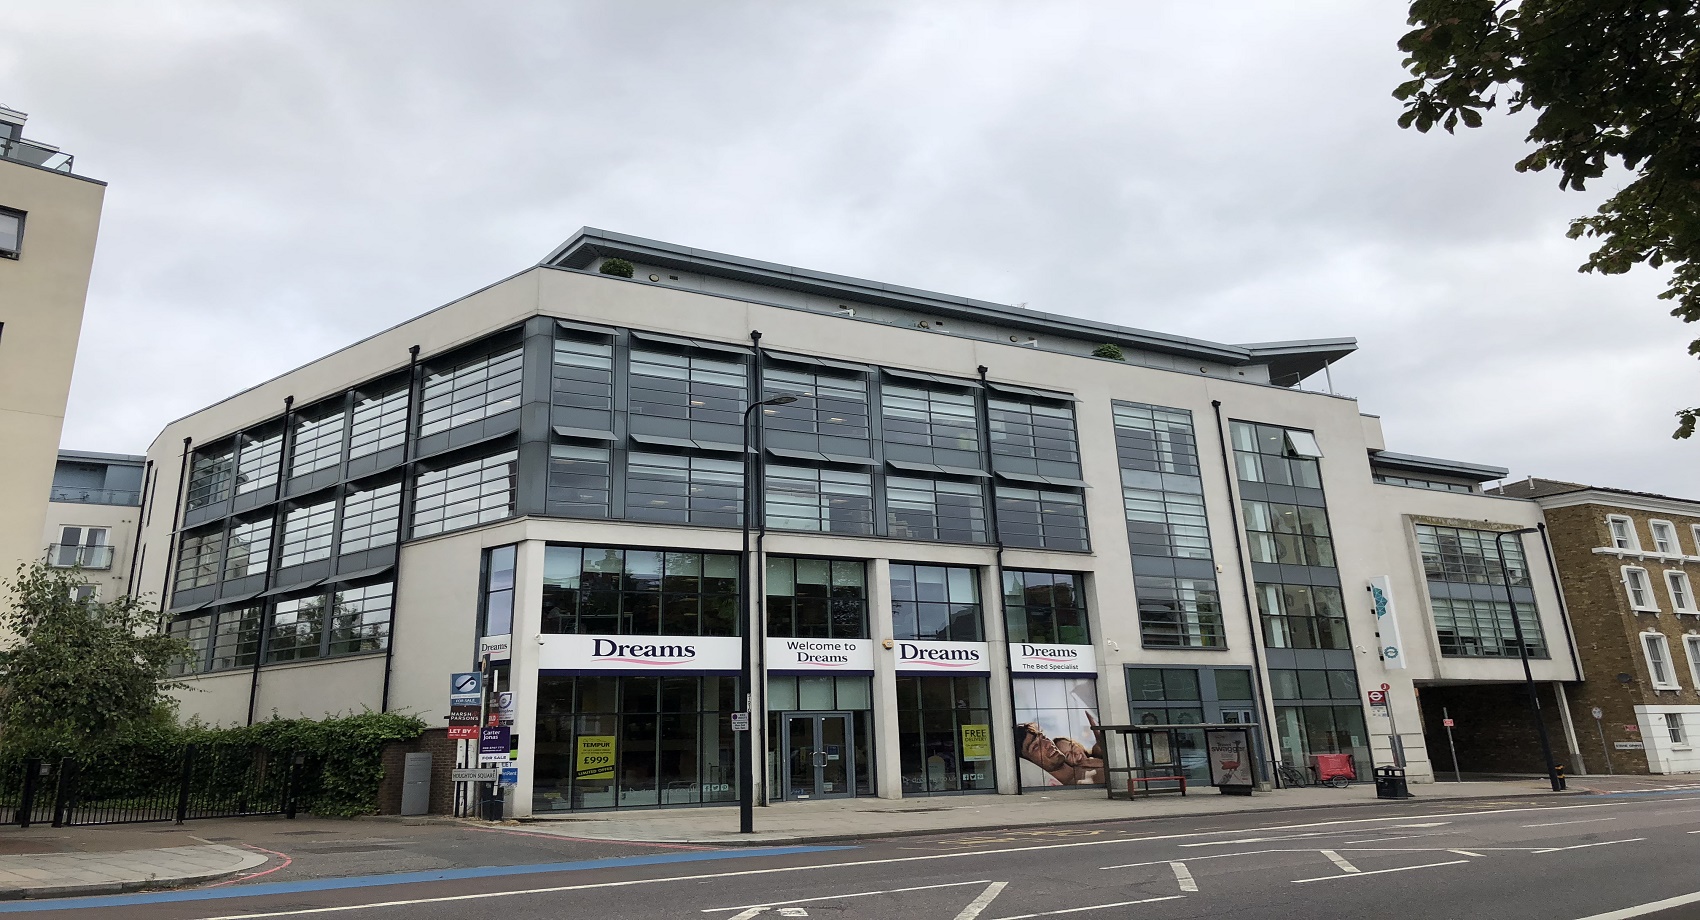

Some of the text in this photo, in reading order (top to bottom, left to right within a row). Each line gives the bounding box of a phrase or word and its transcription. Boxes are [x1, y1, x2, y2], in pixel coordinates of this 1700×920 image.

[481, 643, 508, 652] Dreams
[591, 638, 696, 658] Dreams
[786, 641, 857, 651] Welcome to
[1021, 644, 1078, 658] Dreams
[796, 651, 848, 663] Dreams
[899, 643, 980, 661] Dreams
[964, 729, 987, 738] FREE
[1211, 746, 1246, 754] swagger
[583, 756, 609, 765] £999
